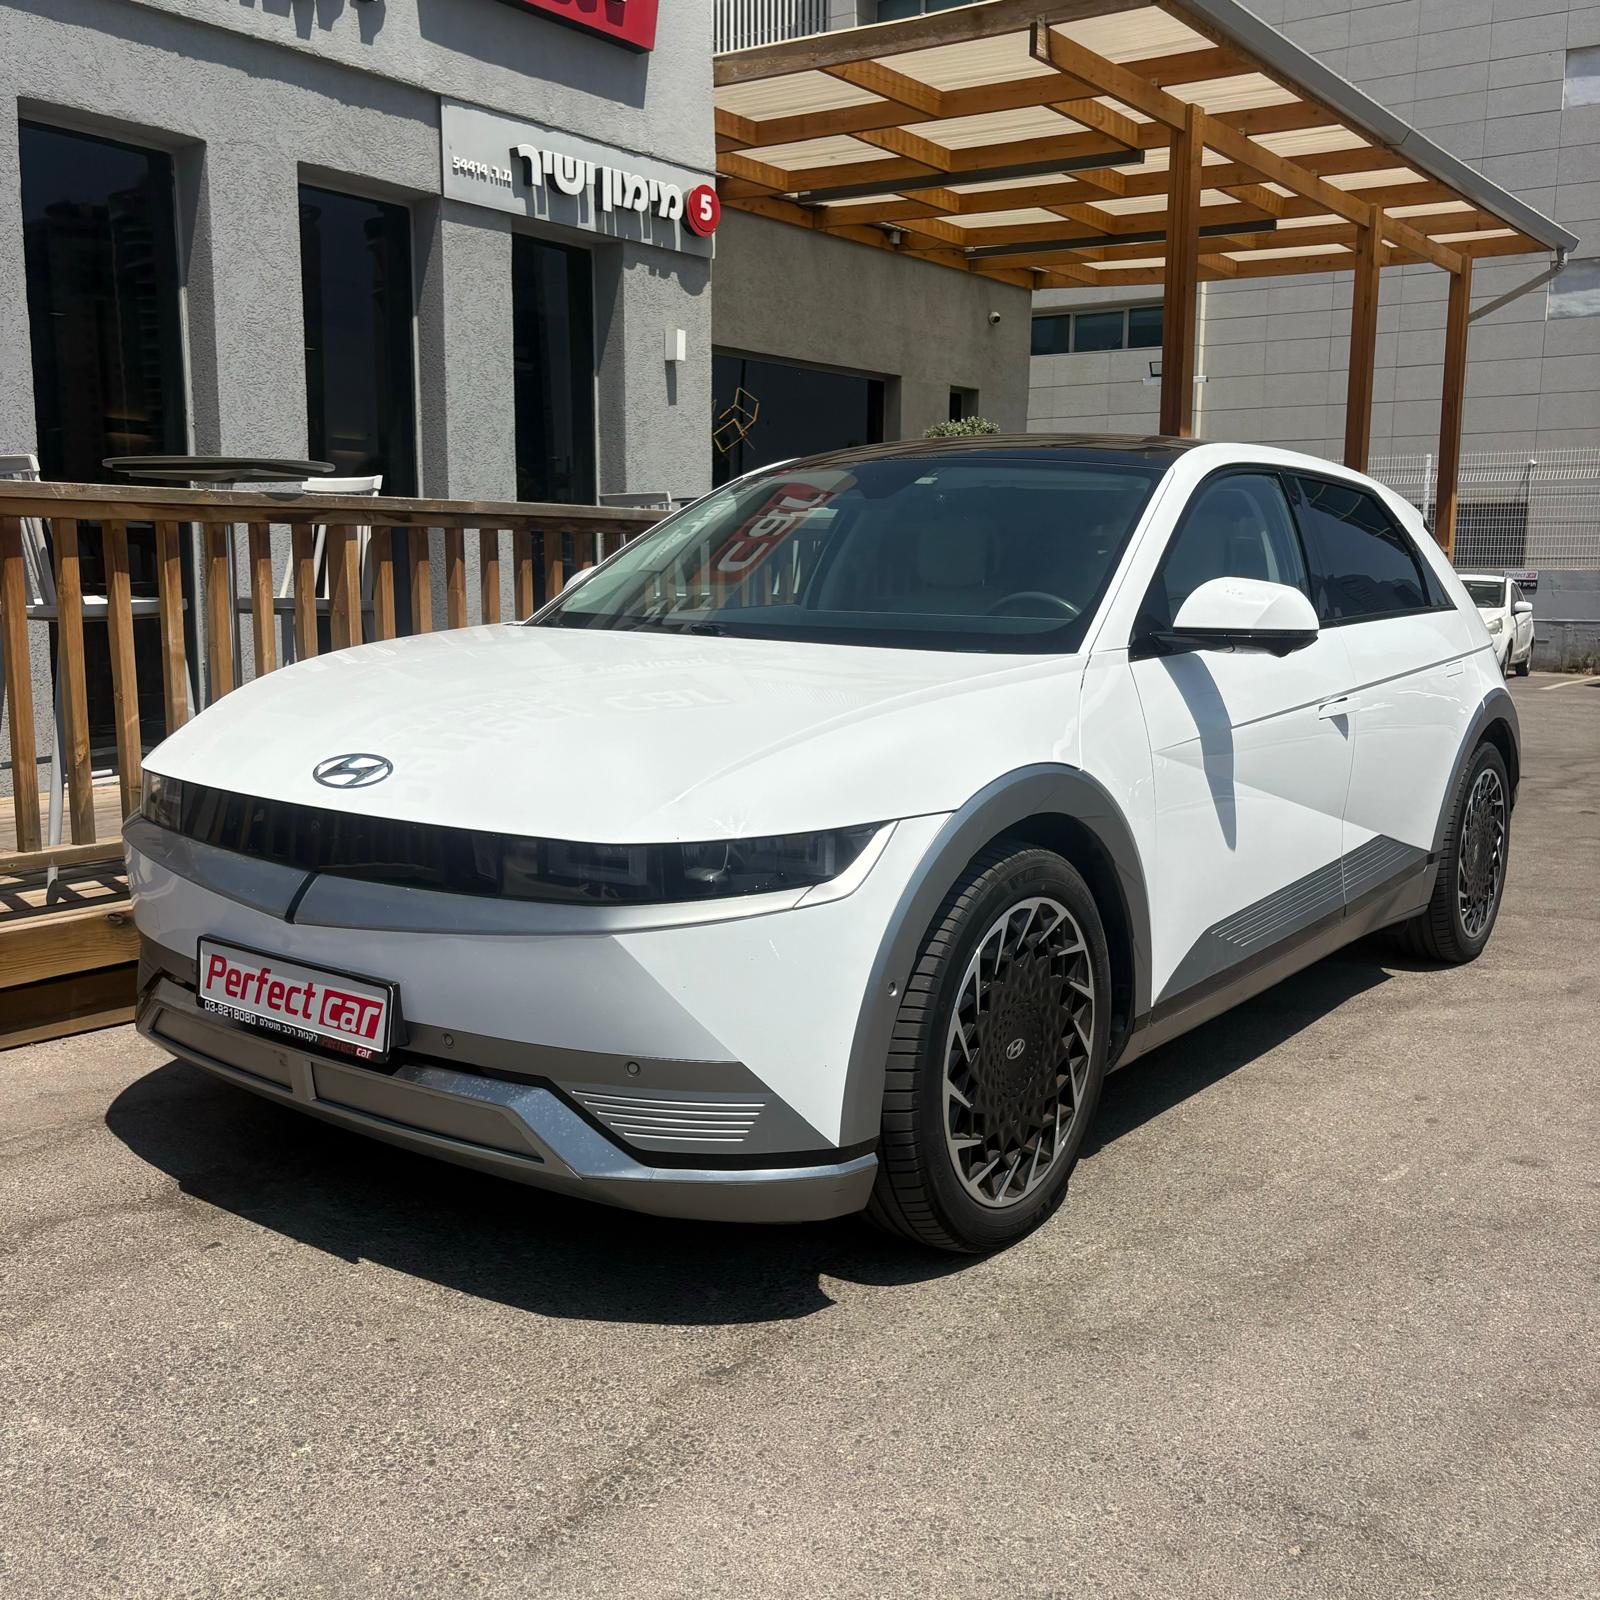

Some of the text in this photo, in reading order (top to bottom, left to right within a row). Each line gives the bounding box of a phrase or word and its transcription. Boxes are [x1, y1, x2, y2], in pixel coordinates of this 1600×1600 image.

[452, 156, 489, 176] 54414
[516, 143, 713, 221] 5 מימון ישיר
[206, 954, 381, 1037] Perfect car
[259, 1018, 318, 1042] לקנות רכב מושלם
[355, 1047, 373, 1060] car
